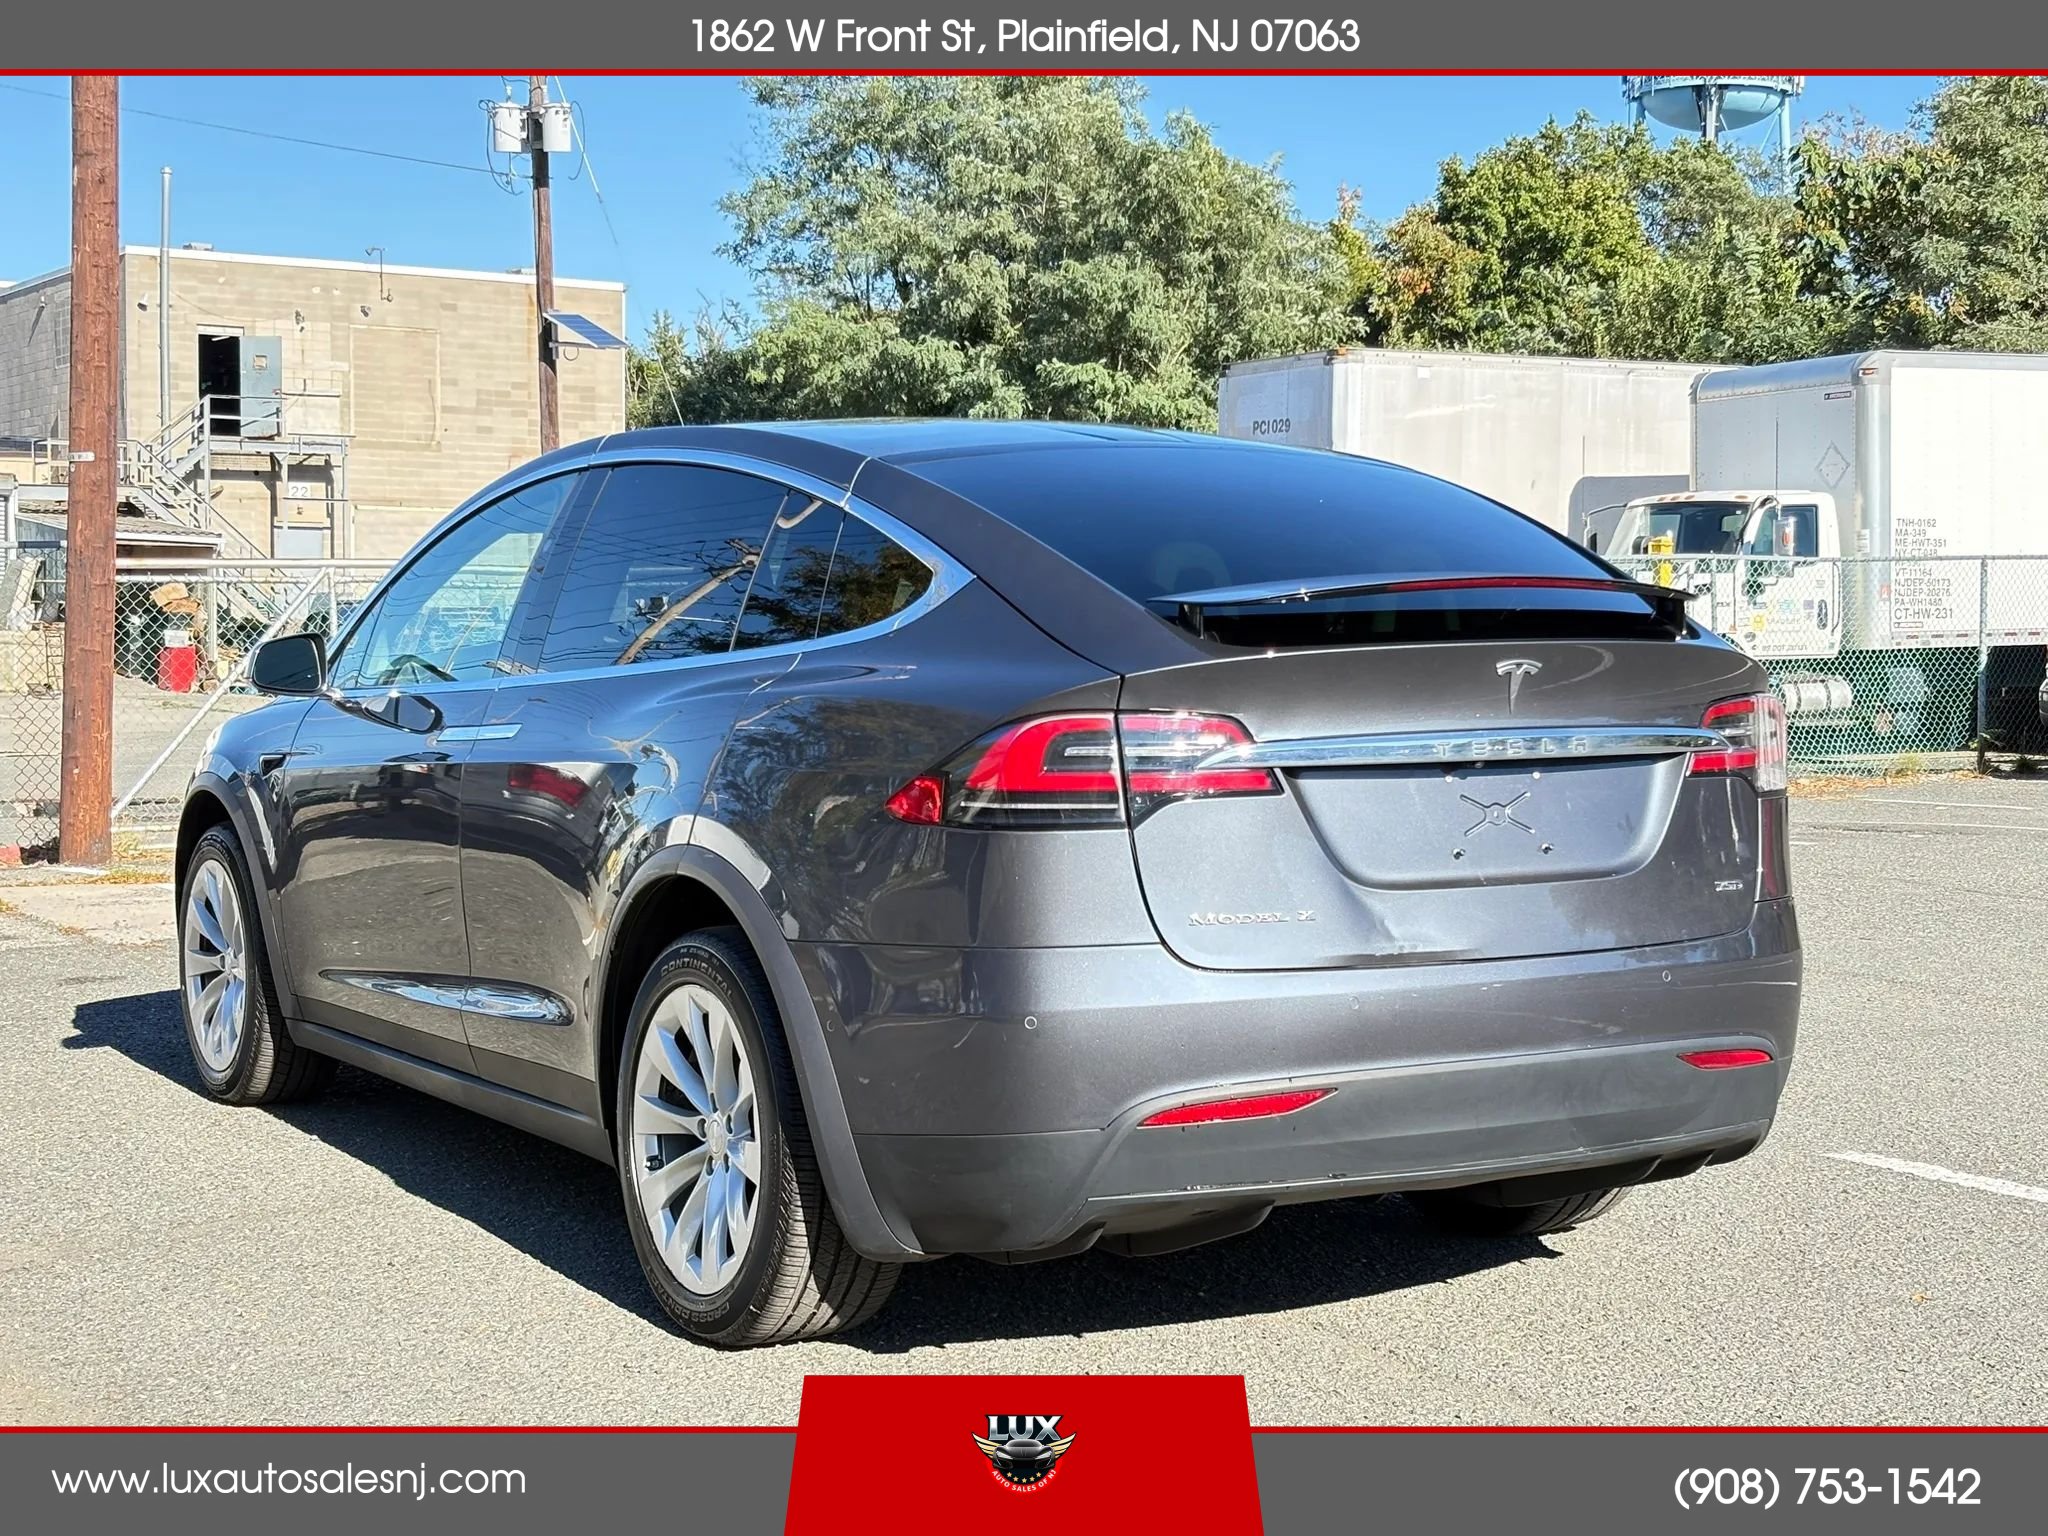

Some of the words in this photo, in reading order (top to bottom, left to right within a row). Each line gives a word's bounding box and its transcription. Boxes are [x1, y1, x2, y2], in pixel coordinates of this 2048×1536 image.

[1271, 418, 1291, 434] 029
[291, 486, 309, 498] 22
[1896, 518, 1937, 528] TNH-0162
[1895, 528, 1927, 538] MA-349
[1894, 607, 1953, 620] CT-HW-231
[1436, 735, 1588, 758] TESLA
